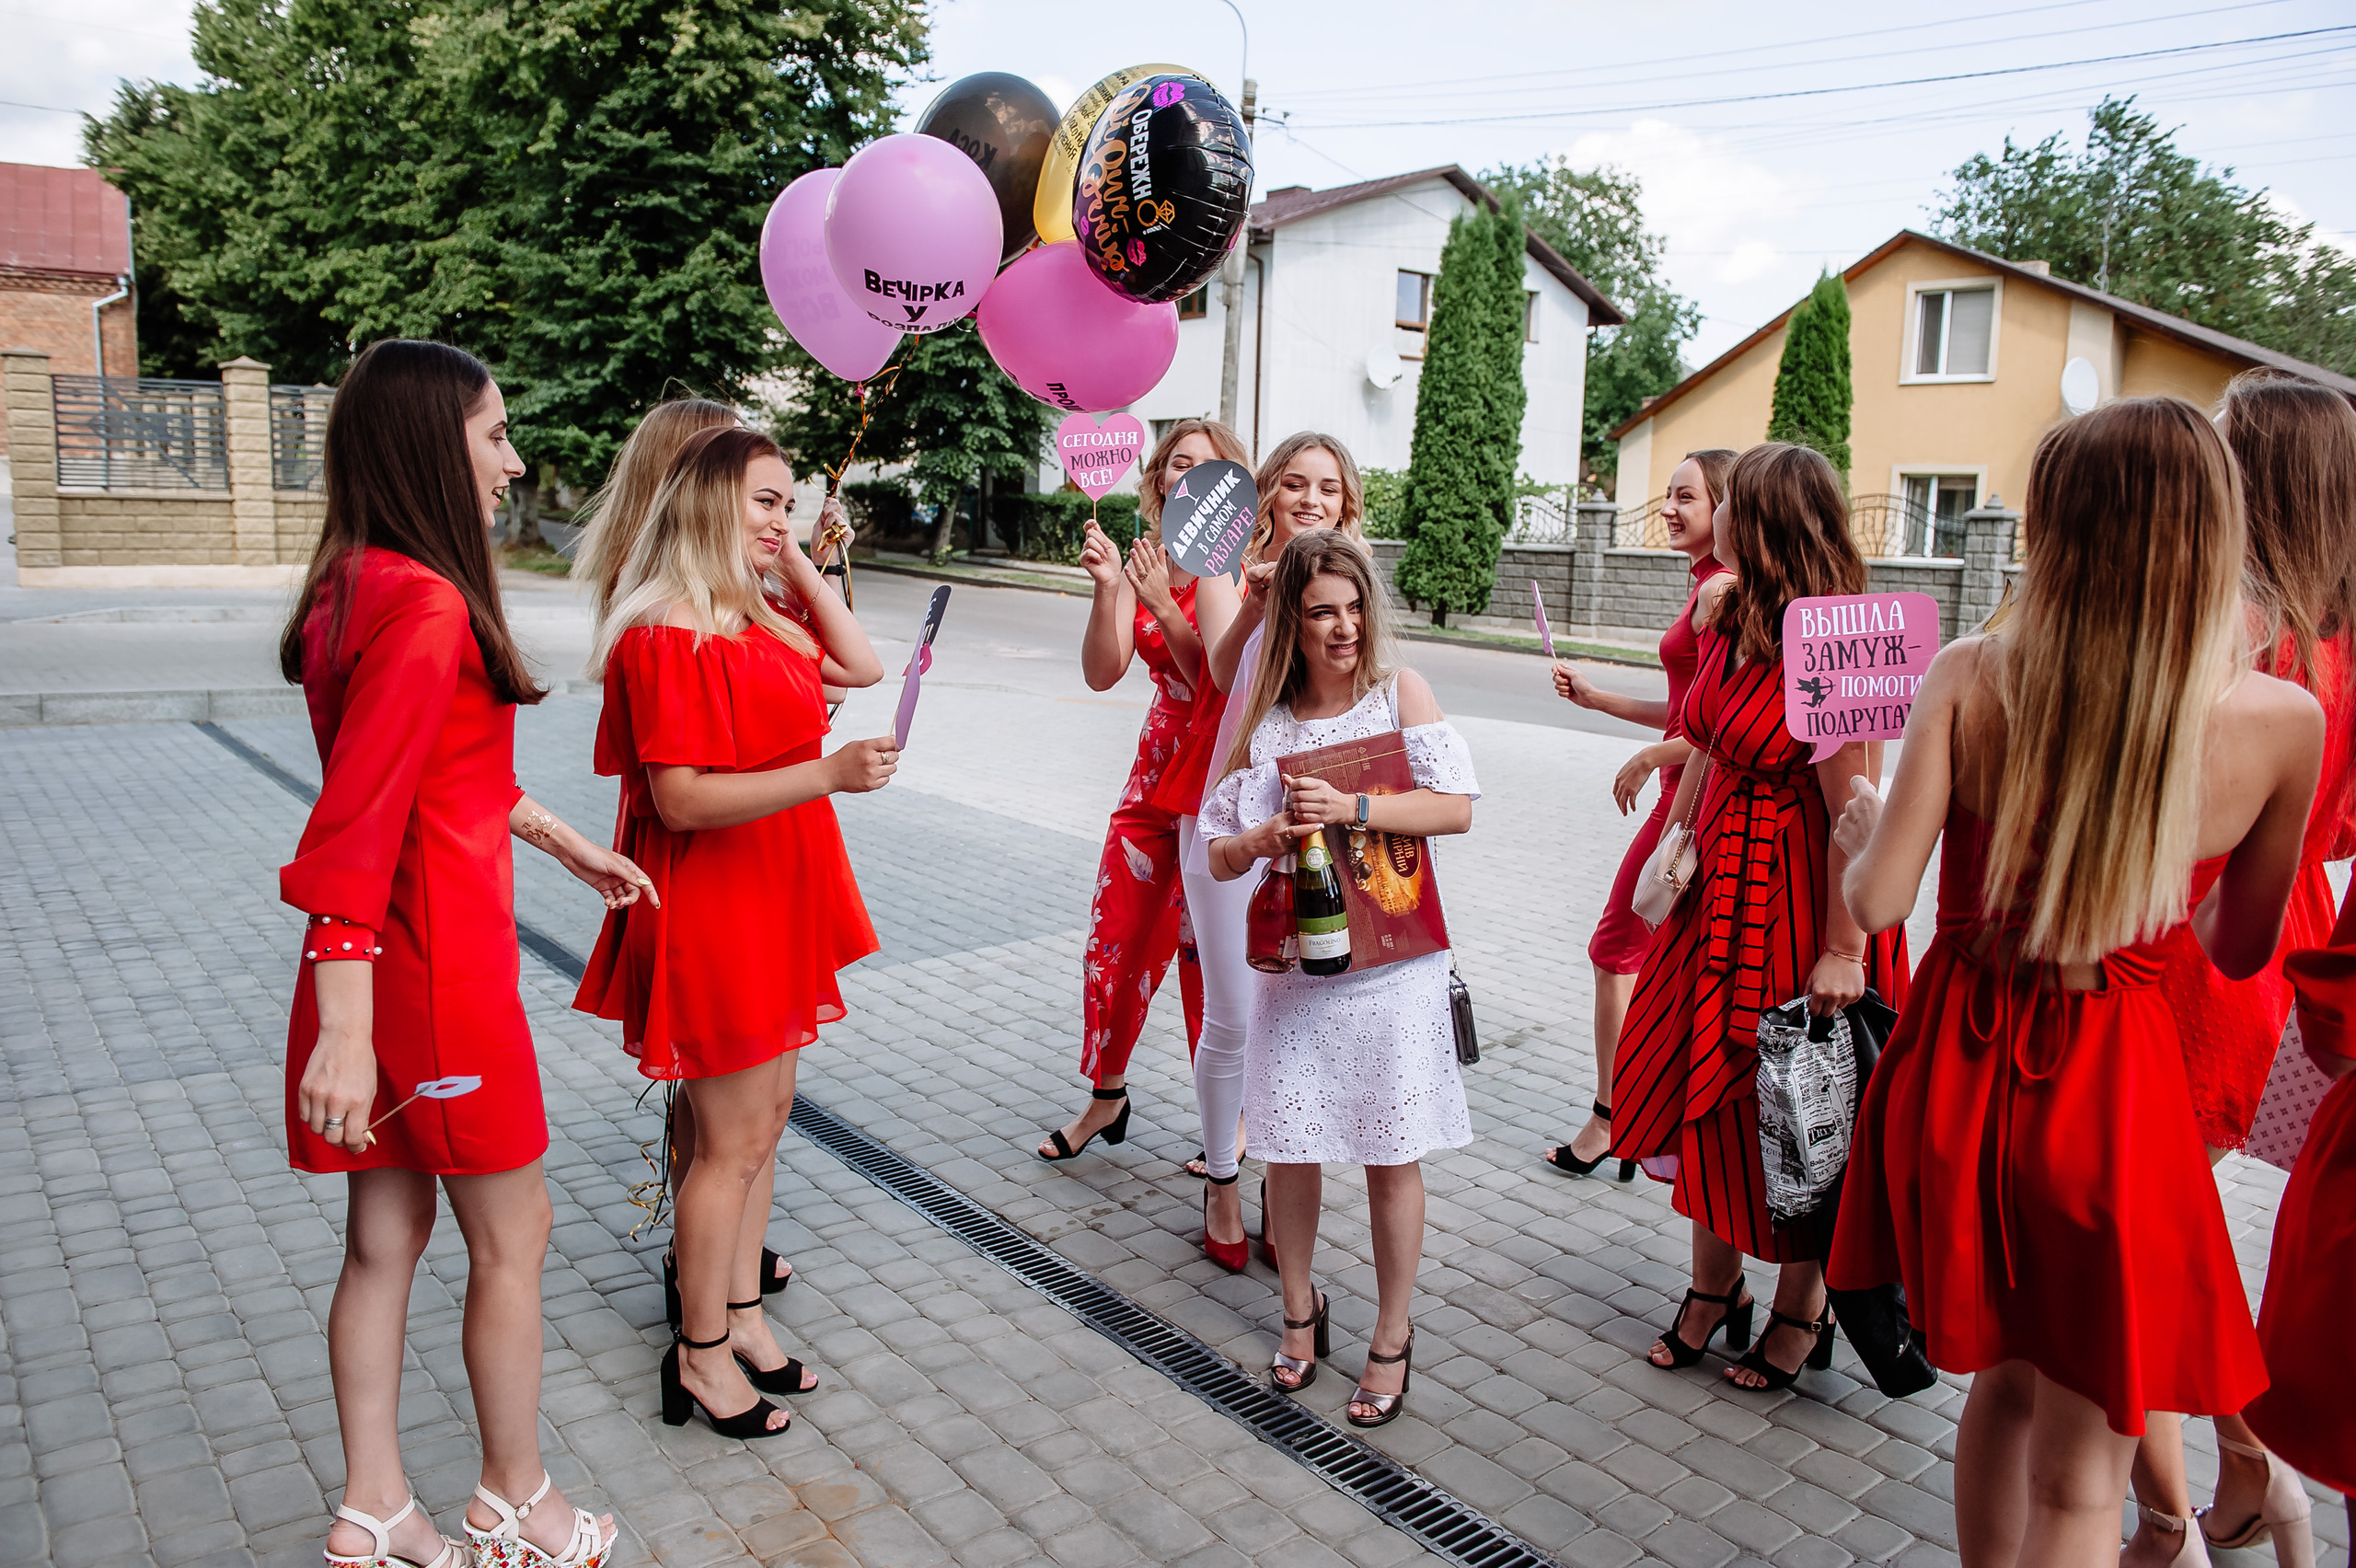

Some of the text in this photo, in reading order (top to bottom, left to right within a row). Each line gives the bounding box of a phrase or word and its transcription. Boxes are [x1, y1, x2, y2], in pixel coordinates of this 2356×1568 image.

[863, 268, 965, 302] ВЕЧІРКА
[902, 305, 929, 322] У
[1062, 431, 1139, 448] СЕГОДНЯ
[1069, 447, 1132, 471] МОЖНО
[1079, 467, 1114, 489] ВСЁ!
[1171, 467, 1242, 559] ДЕВИЧНИК
[1196, 499, 1238, 556] В САМОМ
[1204, 506, 1256, 577] РАЗГАРЕ!
[1798, 600, 1906, 639] ВЫШЛА
[1841, 674, 1924, 698] ПОМОГИ
[1309, 938, 1341, 946] FRAGOLINO
